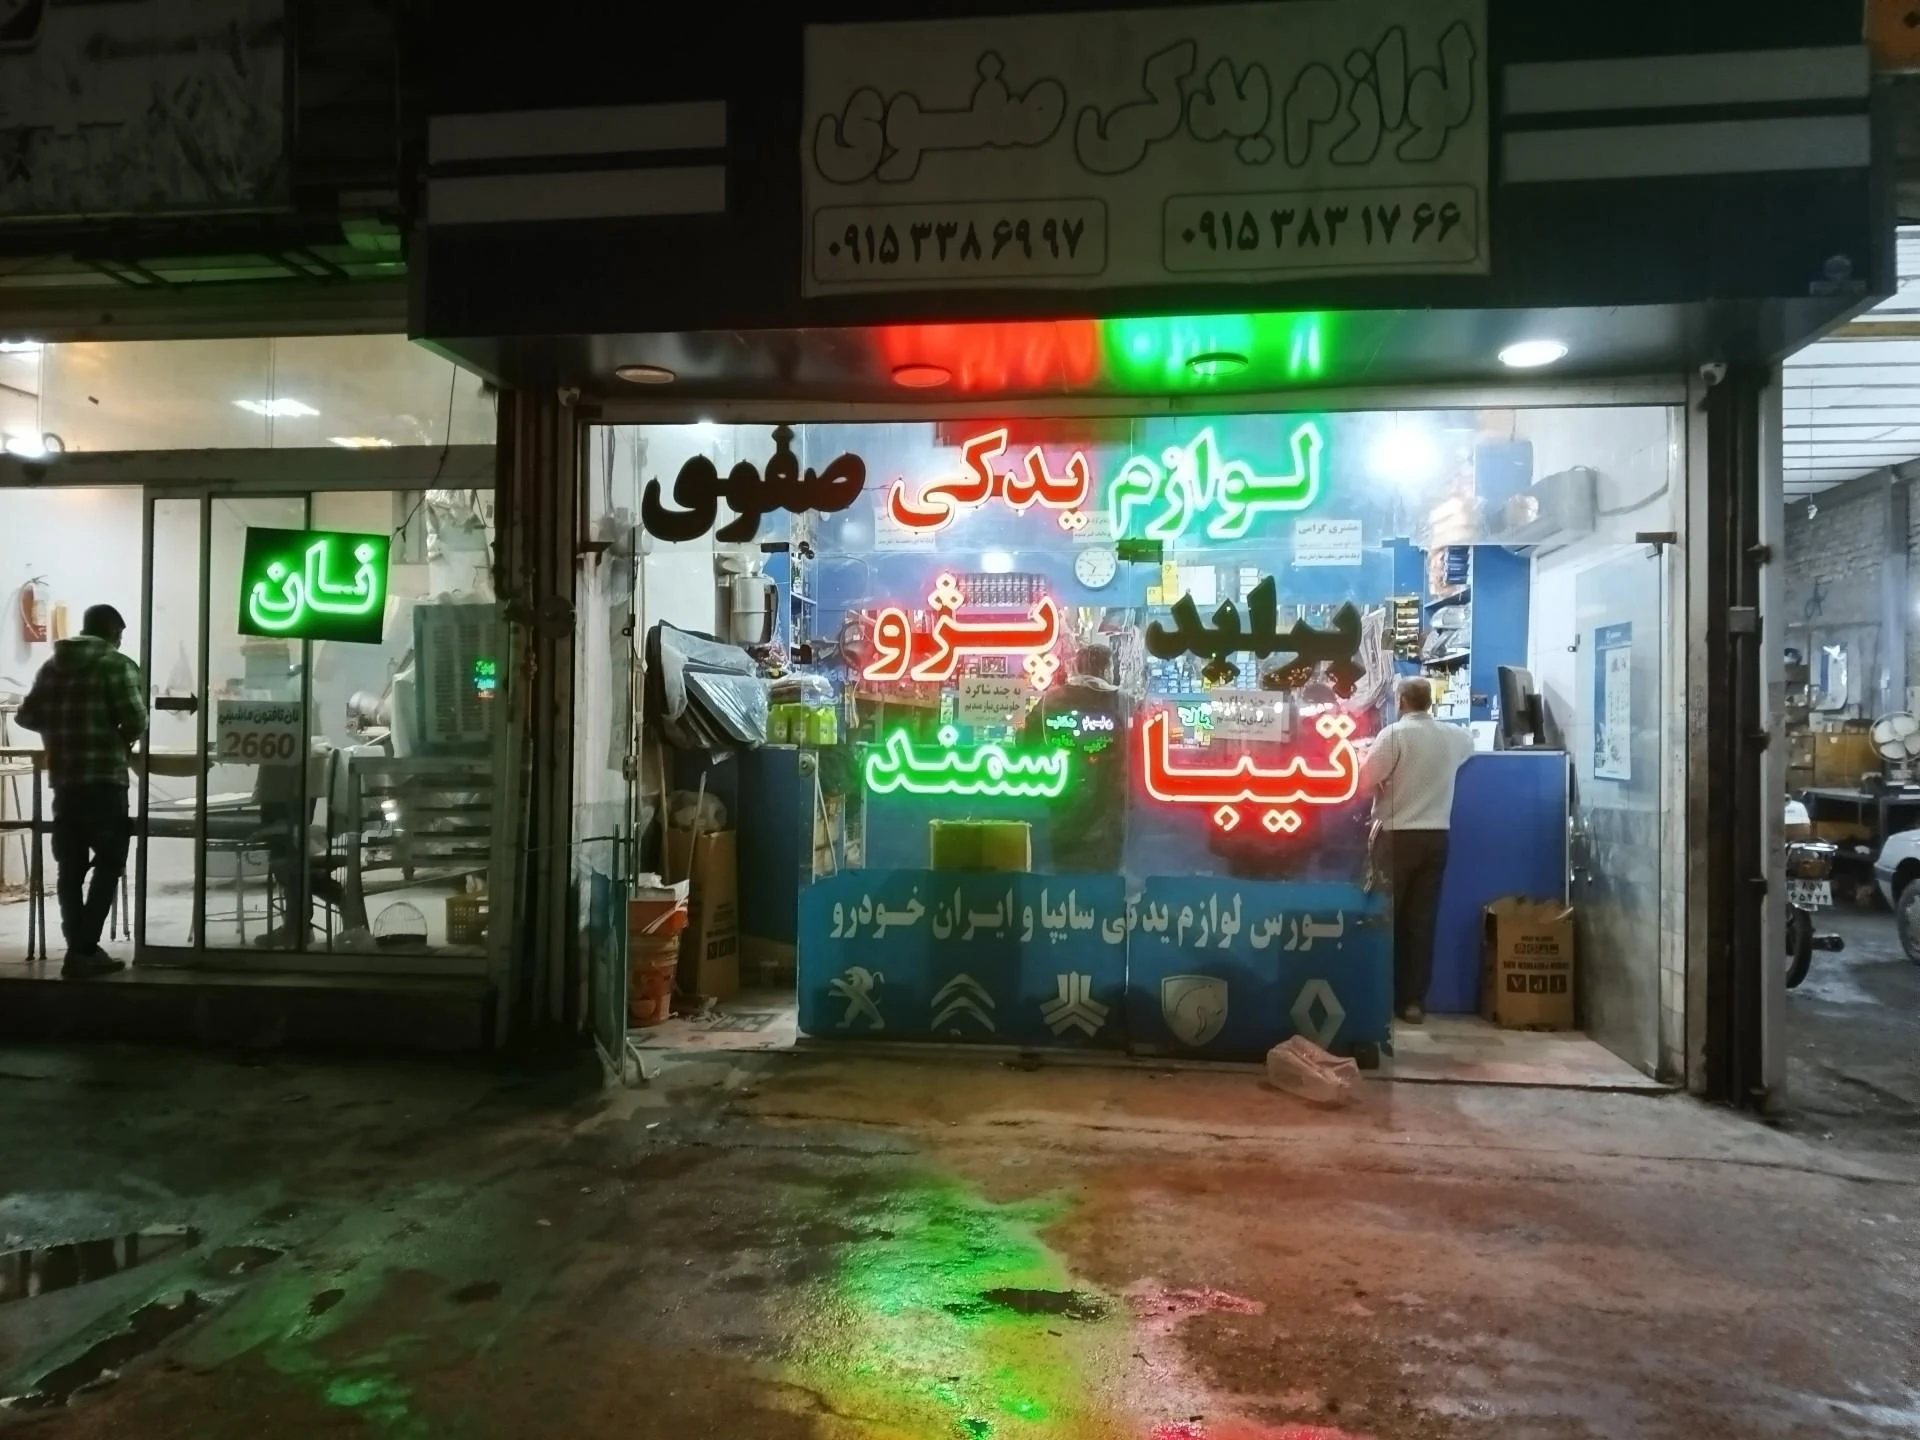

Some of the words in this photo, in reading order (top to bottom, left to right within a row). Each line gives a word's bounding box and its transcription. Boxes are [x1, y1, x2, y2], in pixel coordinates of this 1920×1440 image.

[813, 50, 1067, 184] صفوی
[1074, 39, 1272, 175] یدکی
[1284, 21, 1476, 168] لوازم
[642, 424, 866, 543] صفوی
[887, 428, 1089, 531] یدکی
[1108, 423, 1323, 542] لوازم
[247, 540, 378, 631] نان
[862, 571, 1059, 691] پژو
[1145, 575, 1366, 700] پراید
[222, 731, 295, 760] 2660
[864, 725, 1070, 797] سمند
[1144, 709, 1360, 832] تیبا
[829, 886, 926, 939] خودرو
[932, 886, 1013, 940] ایران
[1019, 905, 1034, 942] و
[1040, 887, 1095, 944] سایپا
[1101, 889, 1169, 945] یدکی
[1177, 892, 1242, 949] لوازم
[1250, 908, 1344, 951] بورس
